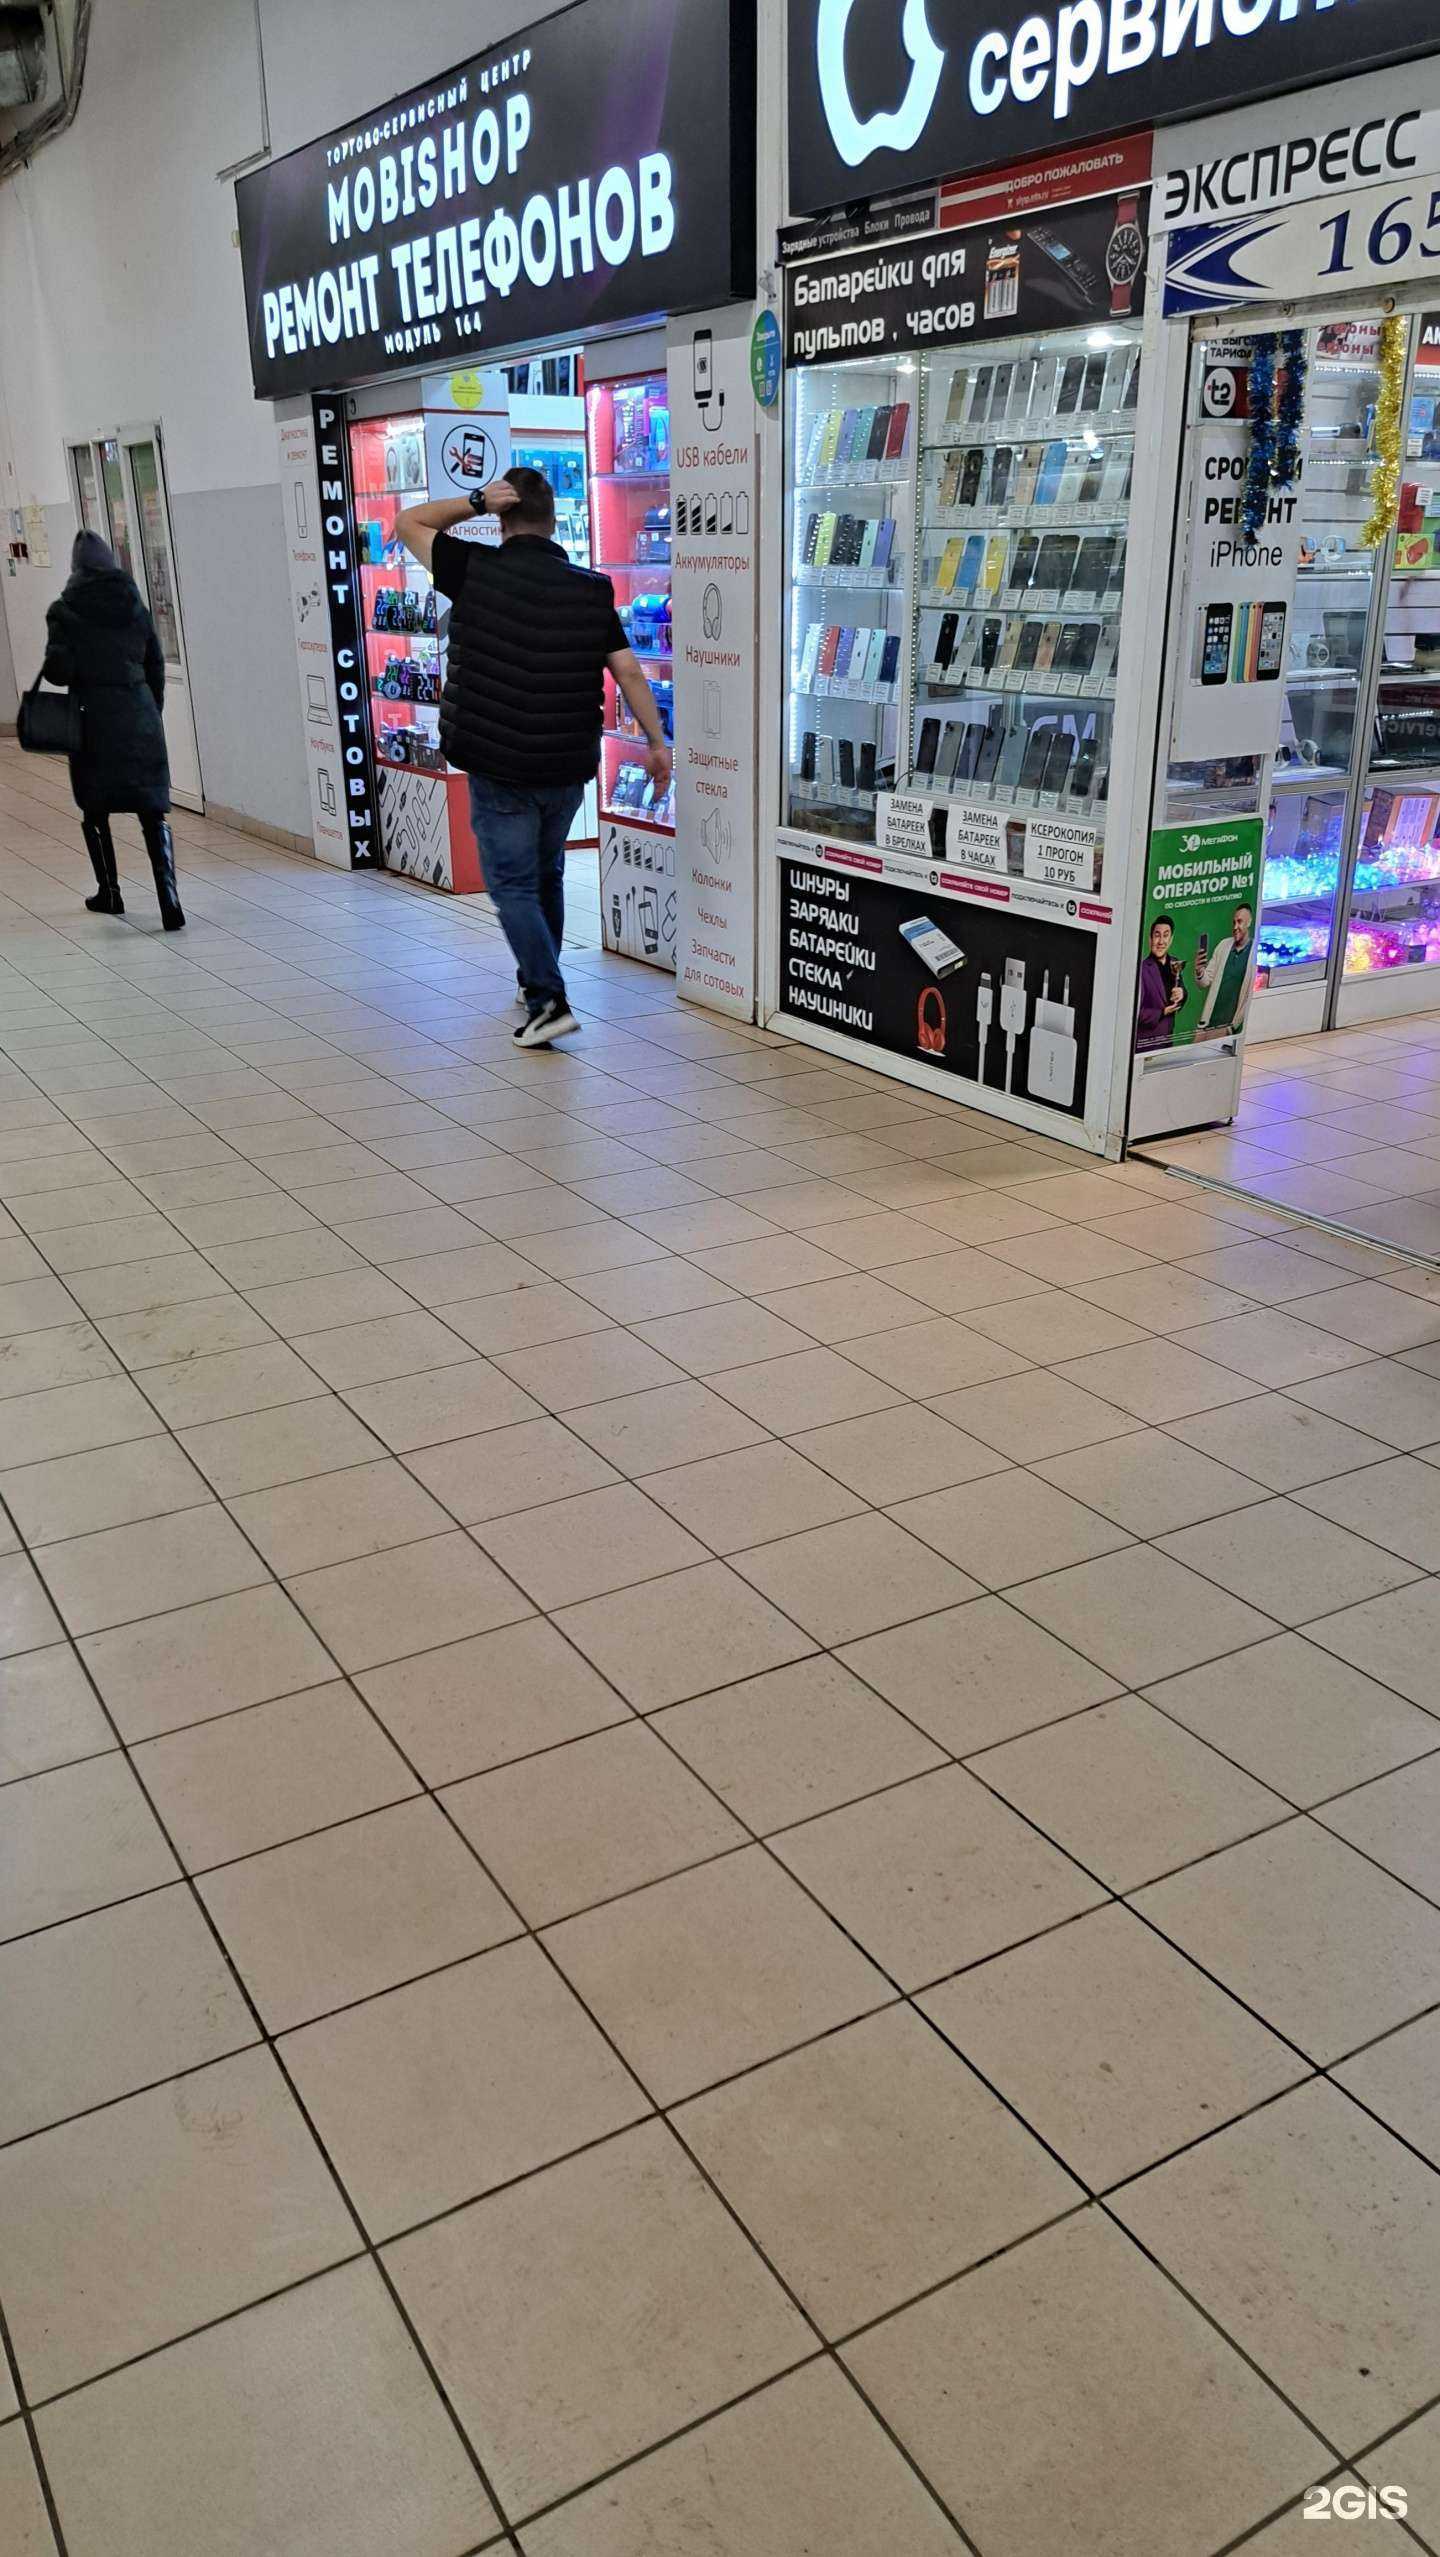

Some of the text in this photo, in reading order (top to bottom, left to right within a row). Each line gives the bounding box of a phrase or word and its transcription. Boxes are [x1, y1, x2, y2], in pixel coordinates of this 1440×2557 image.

[480, 49, 532, 94] ЦЕНТР
[968, 0, 1338, 119] серви
[326, 93, 532, 245] MOBISHOP
[1006, 172, 1043, 193] ДОБРО
[1044, 152, 1124, 183] ПОЖАЛОВАТЬ
[1164, 109, 1422, 220] ЭКСПРЕСС
[782, 209, 930, 255] Зарядные устройства Блоки Провода
[262, 152, 676, 359] РЕМОНТ ТЕЛЕФОНОВ
[794, 248, 966, 307] Батарейки для
[384, 317, 482, 355] МОДУЛЬ 164
[794, 317, 885, 360] пультов
[906, 301, 976, 336] часов
[676, 443, 749, 469] USB кабели
[1204, 497, 1298, 524] РЕНТ
[675, 552, 750, 574] Аккумуляторы
[1210, 540, 1284, 568] iPhone
[319, 408, 373, 860] РЕМОНТ СОТОВЫХ
[685, 644, 741, 668] Наушники
[688, 747, 739, 772] Защитные
[695, 780, 728, 799] стекла
[889, 798, 924, 815] ЗАМЕНА
[962, 811, 998, 828] ЗАМЕНА
[887, 816, 926, 833] БАТАРЕЕК
[1031, 822, 1095, 844] КСЕРОКОПИЯ
[885, 834, 927, 852] В БРЕЛКАХ
[958, 830, 1001, 848] БАТАРЕЕК
[961, 849, 996, 866] В ЧАСАХ
[1044, 846, 1084, 863] ПРОГОН
[1158, 852, 1253, 880] МОБИЛЬНЫЙ
[691, 867, 732, 893] Колонки
[790, 869, 849, 902] ШНУРЫ
[1044, 866, 1077, 882] 10 РУБ
[1152, 872, 1254, 900] ОПЕРАТОР №1
[697, 906, 728, 930] Чехлы
[789, 899, 859, 935] ЗАРЯДКИ
[690, 939, 736, 968] Запчасти
[789, 928, 876, 971] БАТАРЕЙКИ
[684, 966, 745, 999] для сотовых
[788, 958, 843, 991] СТЕКЛА
[788, 985, 873, 1031] НАУШНИКИ
